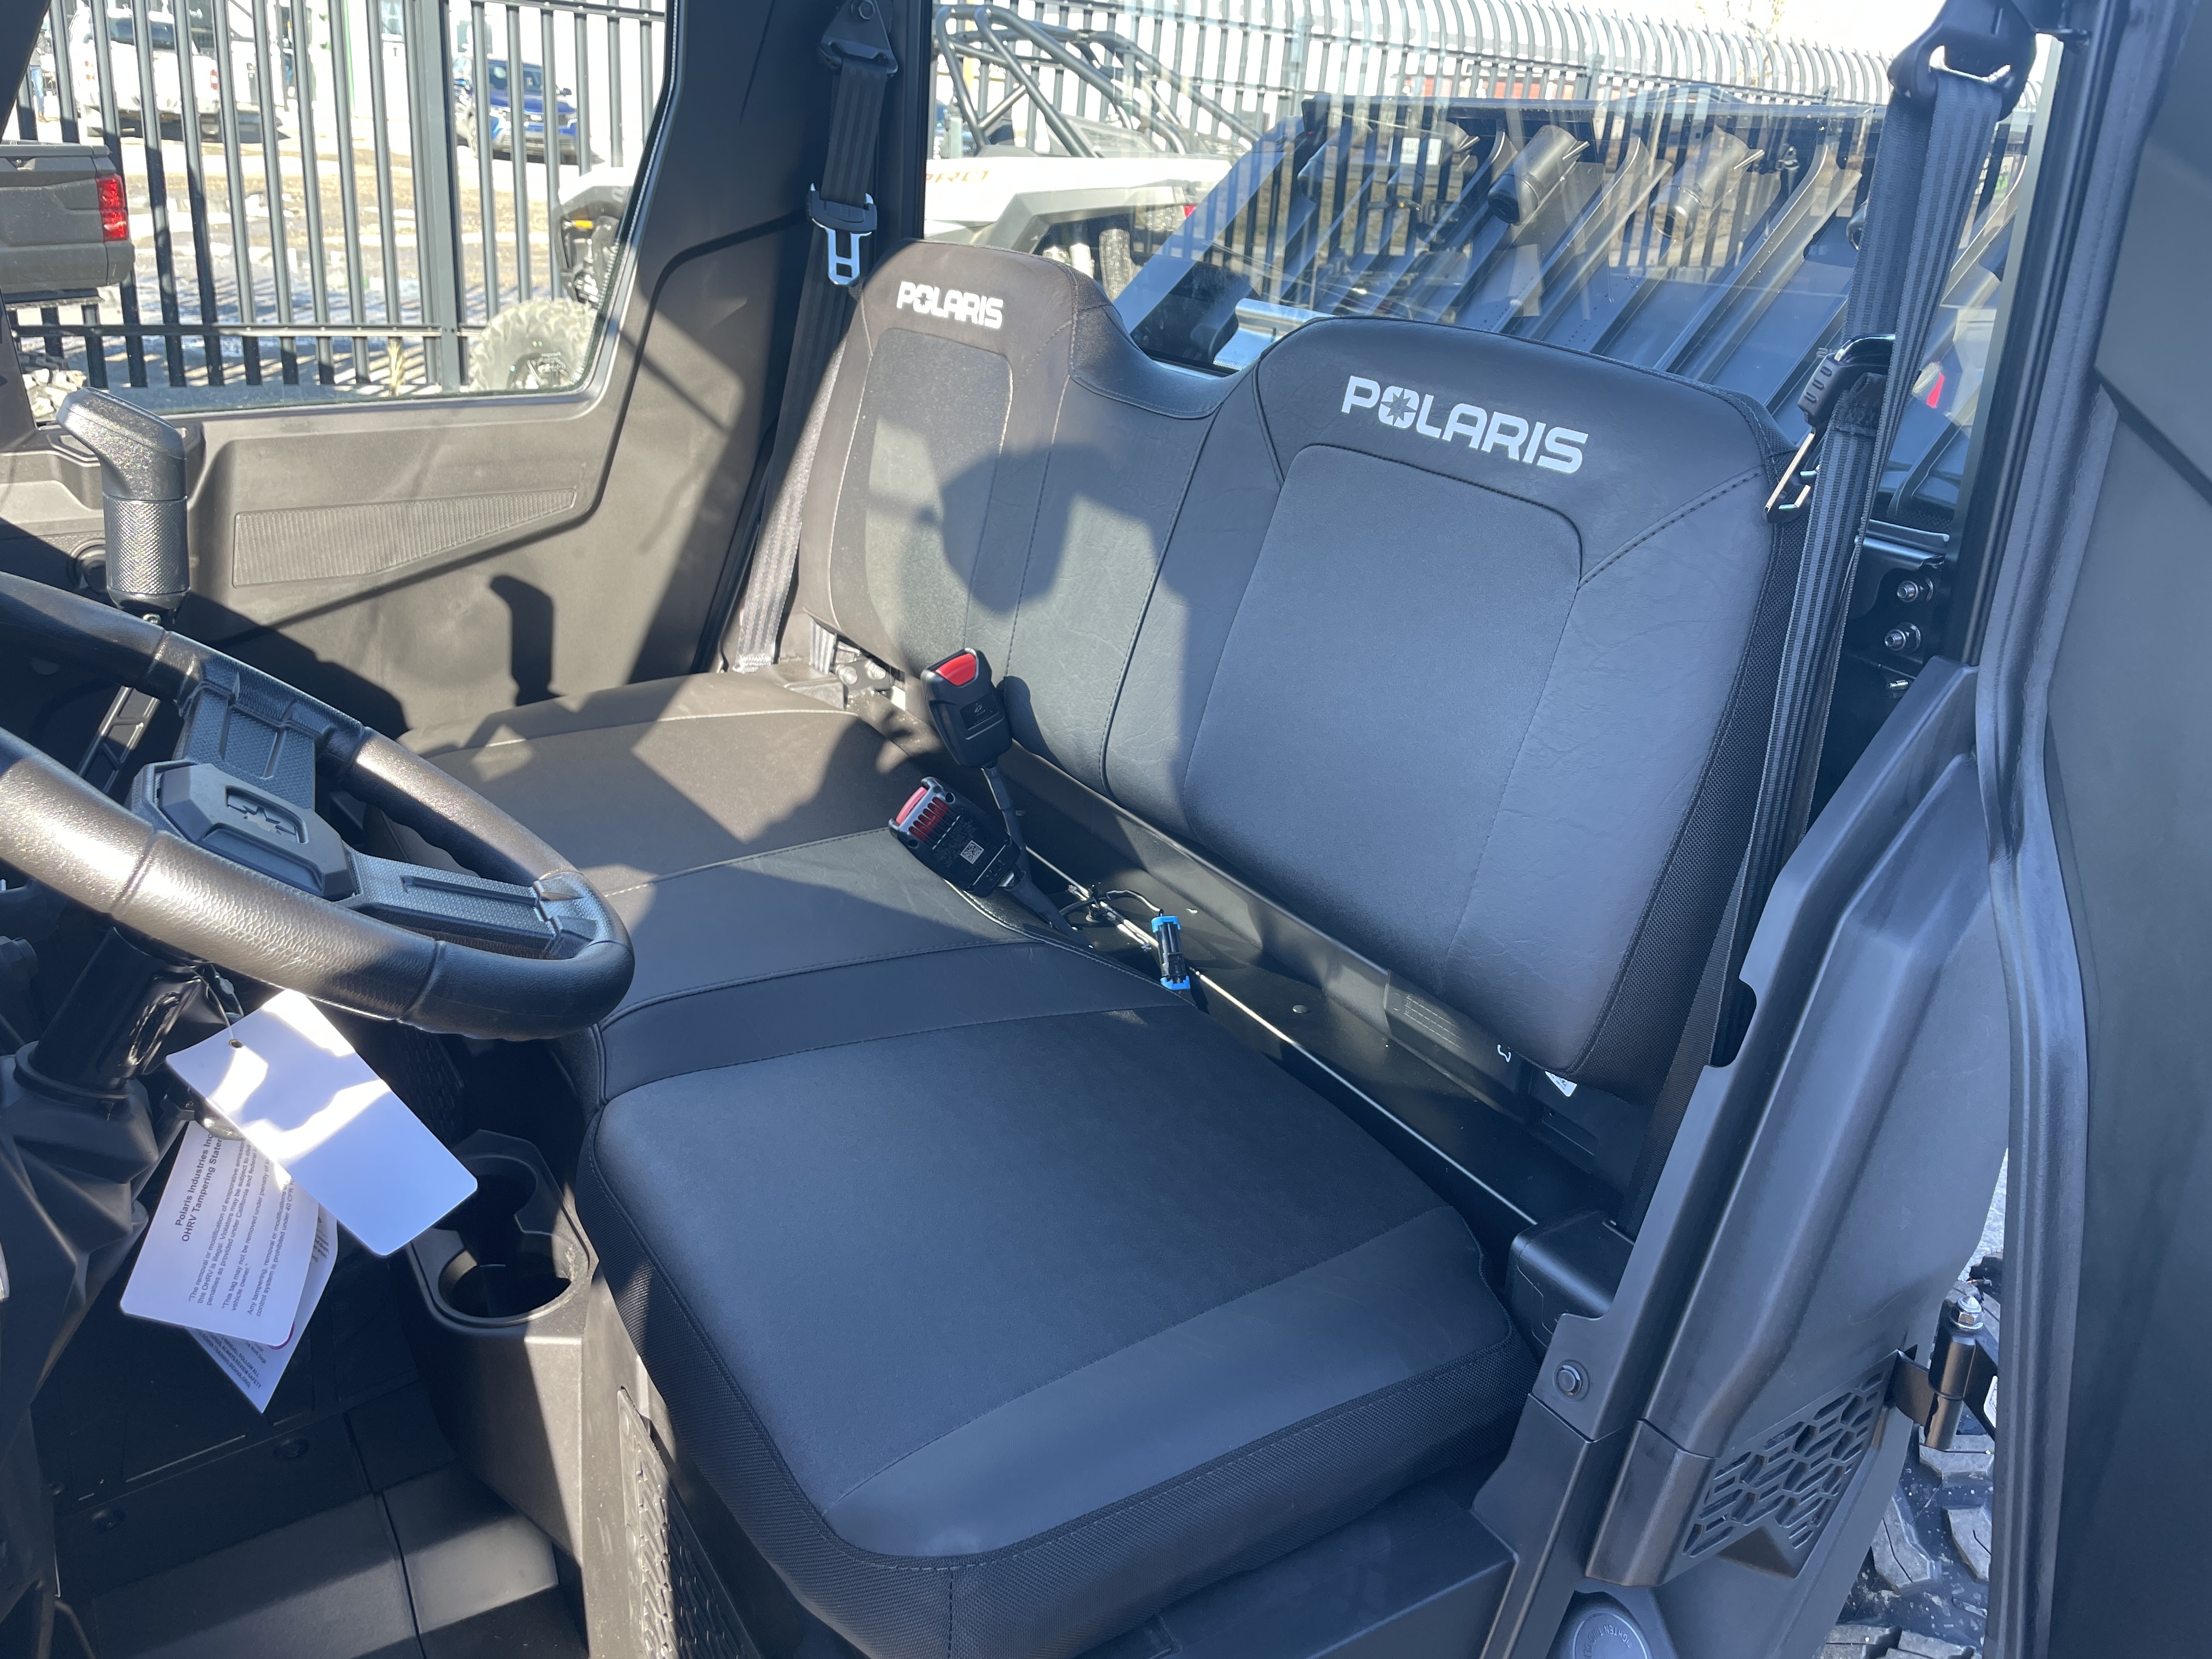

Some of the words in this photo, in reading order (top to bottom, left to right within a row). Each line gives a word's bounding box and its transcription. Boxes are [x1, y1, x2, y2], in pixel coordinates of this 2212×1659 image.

[896, 281, 1004, 329] POLARIS
[1341, 375, 1589, 474] POLARIS
[247, 1152, 257, 1173] federal
[174, 1195, 193, 1226] Polaris
[187, 1149, 208, 1193] Industries
[238, 1164, 247, 1187] subject
[181, 1214, 196, 1242] OHRV
[191, 1166, 216, 1212] Tampering
[229, 1197, 239, 1211] may
[233, 1188, 241, 1197] be
[235, 1188, 249, 1218] California
[285, 1203, 291, 1211] 40
[195, 1259, 208, 1285] removal
[207, 1212, 225, 1250] modification
[224, 1167, 239, 1204] evaporative
[218, 1212, 234, 1240] Violators
[228, 1281, 238, 1291] tag
[233, 1266, 242, 1280] may
[241, 1244, 249, 1253] be
[245, 1215, 257, 1244] removed
[253, 1196, 262, 1215] under
[259, 1173, 269, 1196] penalty
[230, 1218, 239, 1238] under
[281, 1211, 290, 1231] under
[219, 1238, 233, 1266] provided
[246, 1301, 257, 1315] Any
[263, 1240, 275, 1266] removal
[273, 1191, 286, 1231] modifications
[273, 1231, 285, 1263] prohibited
[201, 1269, 213, 1290] OHRV
[217, 1267, 223, 1276] as
[263, 1271, 274, 1294] system
[196, 1292, 206, 1304] this
[206, 1277, 221, 1306] penalties
[230, 1288, 242, 1311] vehicle
[256, 1294, 267, 1317] control
[1603, 1624, 1633, 1649] TIGHTEN
